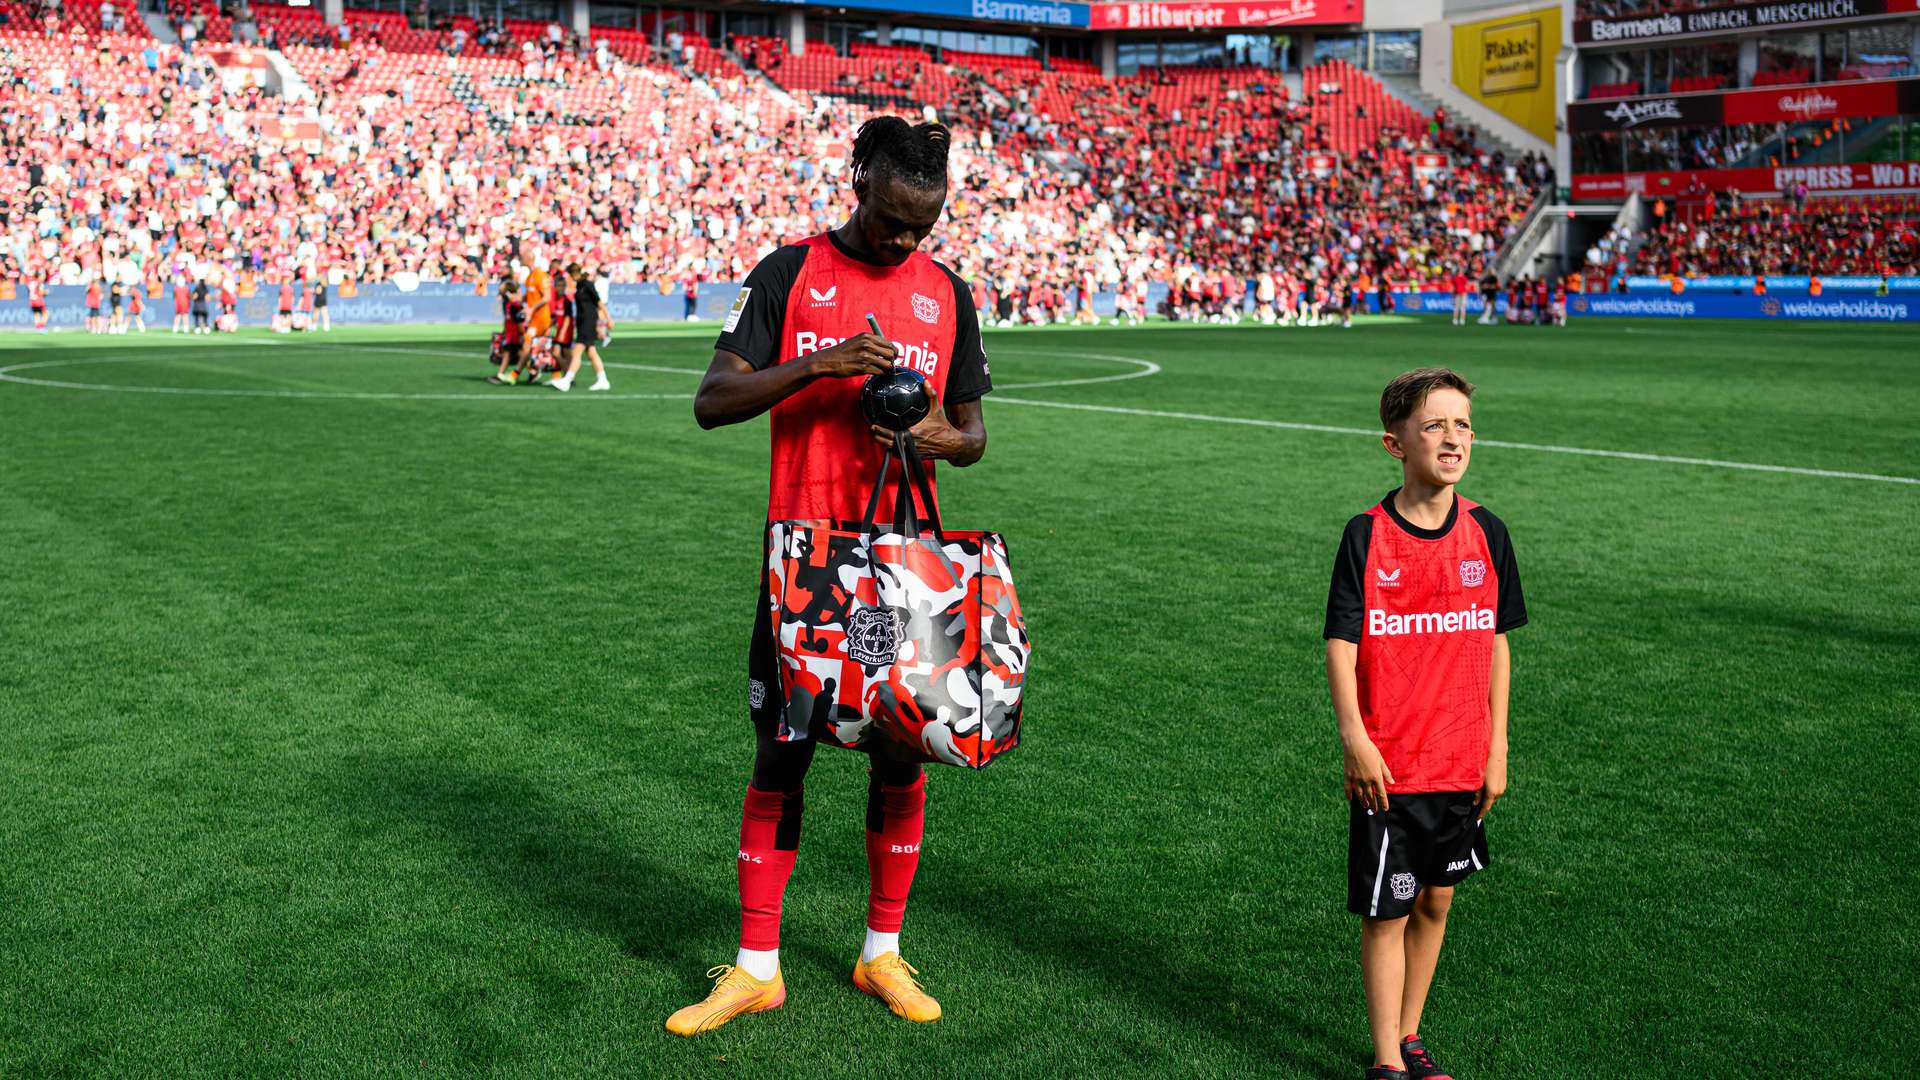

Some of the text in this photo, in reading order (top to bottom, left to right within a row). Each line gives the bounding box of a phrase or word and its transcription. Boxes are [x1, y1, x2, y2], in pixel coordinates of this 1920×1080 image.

[971, 0, 1072, 25] Barmenia
[1128, 3, 1225, 31] Bitburger
[1592, 0, 1859, 41] Barmenia EINFACH. MENSCHLICH.
[1774, 165, 1853, 189] EXPRESS
[1871, 164, 1905, 186] Wo
[1591, 299, 1695, 315] weloveholidays
[1783, 300, 1908, 319] weloveholidays
[1369, 603, 1495, 635] Barmenia
[854, 650, 891, 662] Leverkusen
[891, 843, 919, 853] B04
